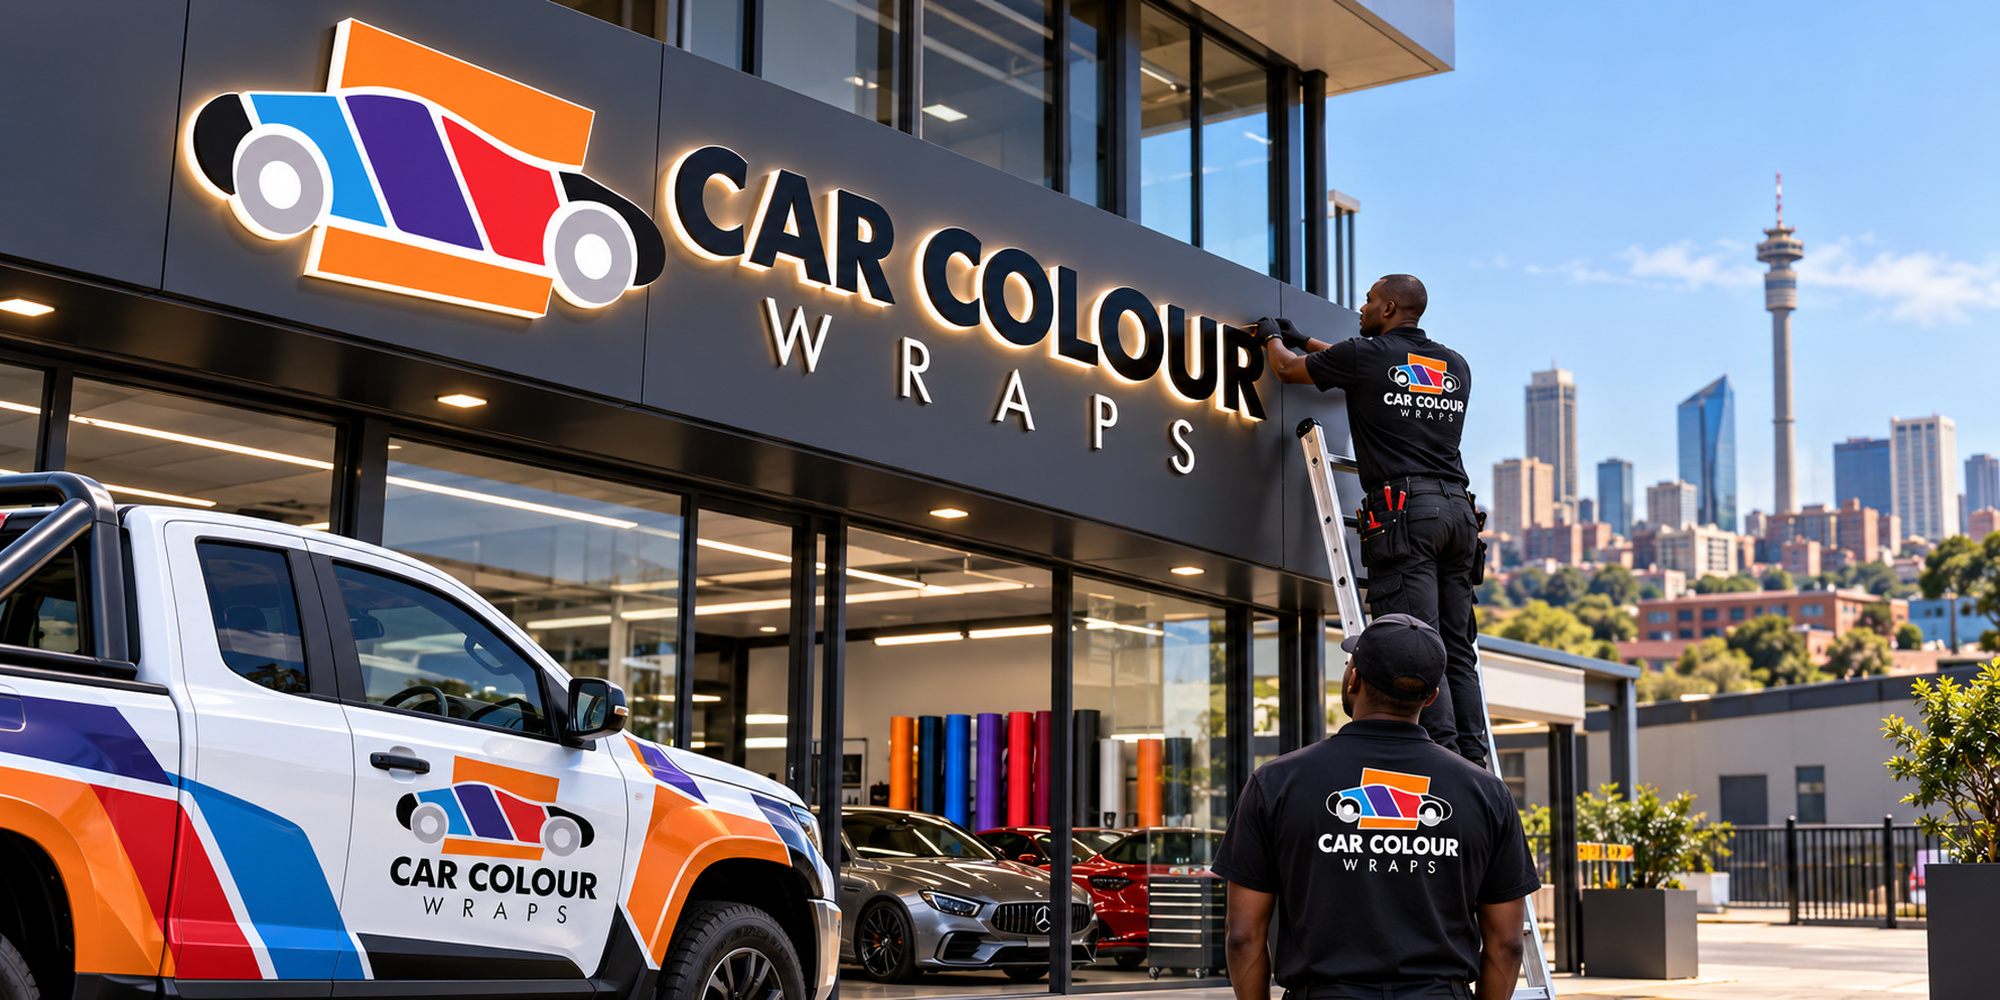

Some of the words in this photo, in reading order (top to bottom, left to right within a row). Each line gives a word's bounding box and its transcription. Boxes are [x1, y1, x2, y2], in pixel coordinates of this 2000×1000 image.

[667, 145, 896, 305] CAR
[917, 226, 1267, 422] COLOUR
[764, 298, 1196, 476] WRAPS
[1383, 392, 1413, 407] CAR
[1416, 396, 1464, 413] COLOUR
[1400, 408, 1453, 422] WRAPS
[1318, 833, 1364, 853] CAR
[1369, 834, 1459, 857] COLOUR
[390, 856, 458, 890] CAR
[468, 862, 598, 900] COLOUR
[1343, 858, 1436, 874] WRAPS
[423, 896, 567, 924] WRAPS
